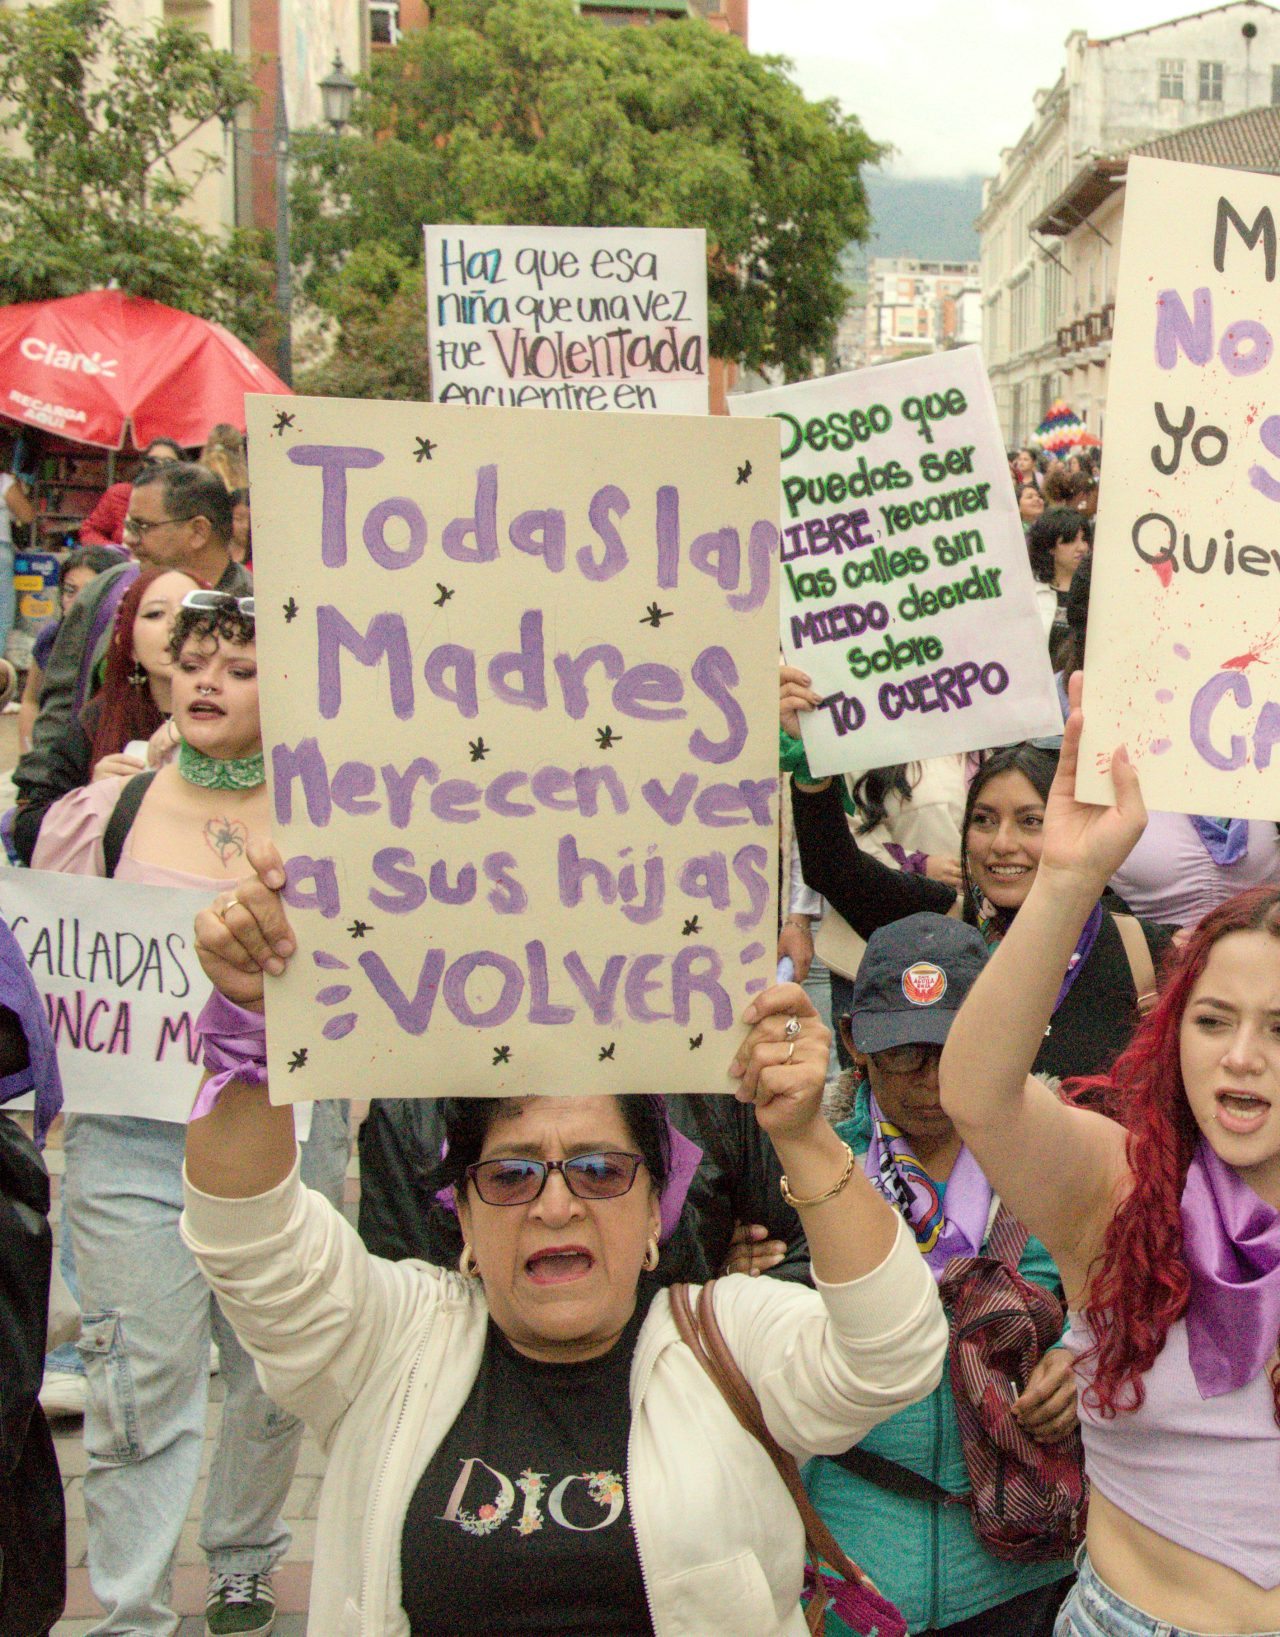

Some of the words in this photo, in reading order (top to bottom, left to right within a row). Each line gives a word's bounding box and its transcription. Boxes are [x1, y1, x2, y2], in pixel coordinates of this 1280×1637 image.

[440, 239, 506, 286] Haz
[515, 248, 580, 290] que
[590, 248, 658, 283] esa
[438, 290, 510, 326] niña
[515, 295, 572, 333] que
[577, 295, 630, 323] una
[633, 290, 692, 322] vez
[1154, 286, 1275, 378] No
[19, 337, 108, 377] Claro
[9, 389, 88, 423] RECARGA
[613, 384, 657, 410] en
[768, 403, 893, 460] Deseo
[900, 387, 968, 443] que
[782, 456, 913, 518] puedas
[919, 445, 976, 483] ser
[879, 482, 991, 536] recorrer
[286, 444, 631, 583] Todas
[655, 485, 779, 613] las
[784, 563, 837, 602] las
[842, 546, 930, 589] calles
[932, 529, 986, 566] sin
[898, 565, 1001, 622] decidir
[316, 604, 749, 765] Madres
[878, 661, 1010, 720] CUERPO
[271, 736, 630, 829] Merecen
[641, 772, 778, 828] ver
[280, 854, 341, 919] a
[369, 846, 528, 915] sus
[558, 833, 770, 931] hijas
[358, 938, 734, 1036] VOLVER
[434, 1458, 626, 1537] DIO
